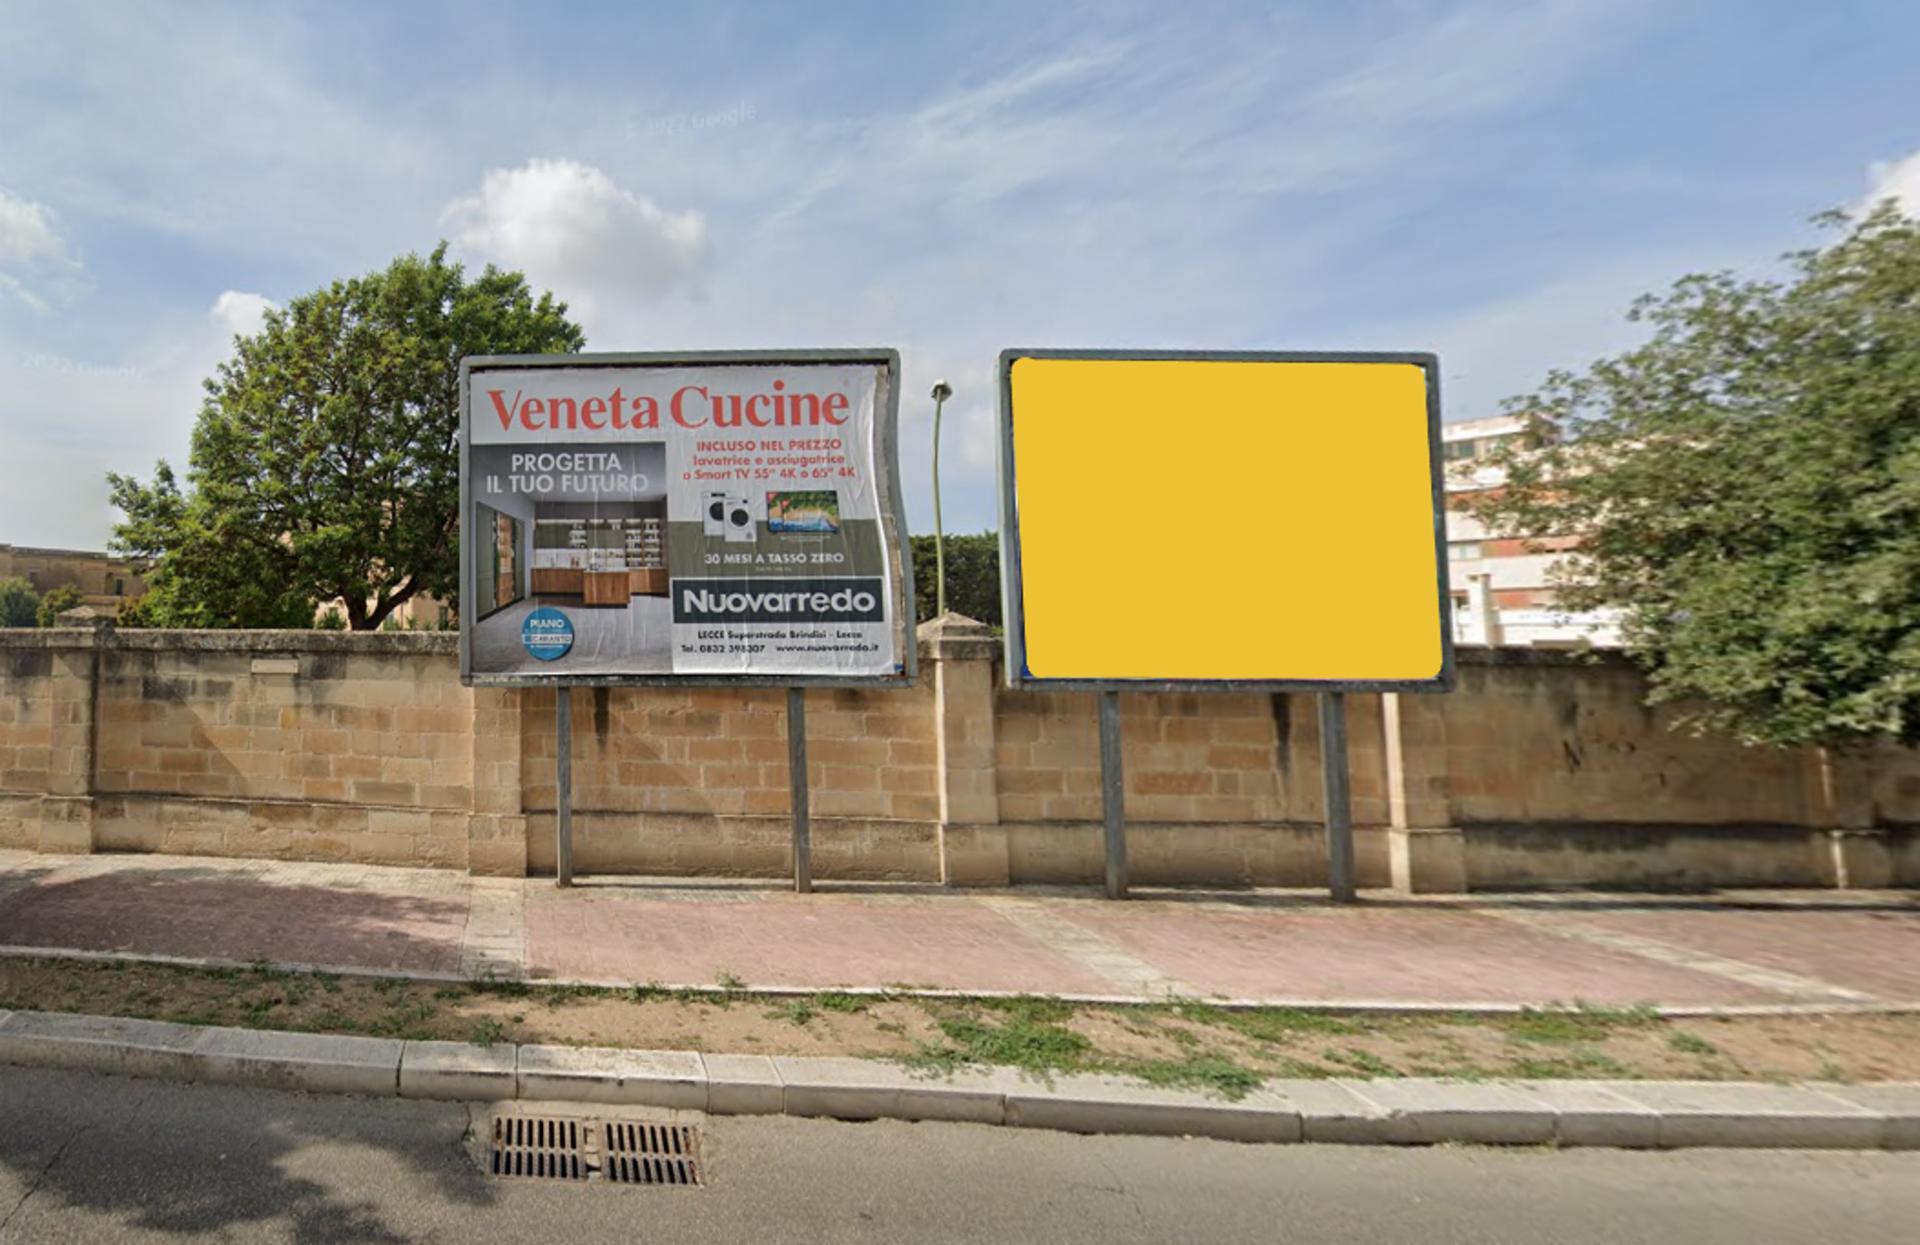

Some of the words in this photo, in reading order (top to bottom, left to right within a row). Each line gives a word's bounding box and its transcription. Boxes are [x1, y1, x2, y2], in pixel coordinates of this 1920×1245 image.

[488, 384, 660, 431] Veneta
[670, 379, 850, 430] Cucine
[696, 440, 756, 451] INCLUSO
[760, 440, 784, 451] NEL
[789, 438, 842, 450] PREZZO
[510, 453, 622, 472] PROGETTA
[693, 455, 751, 466] lavatrice
[754, 457, 763, 465] e
[767, 453, 845, 467] asciugatrice
[694, 469, 731, 480] Smart
[735, 469, 750, 479] TV
[780, 468, 797, 478] 4K
[838, 466, 856, 478] 4K
[486, 475, 502, 493] IL
[508, 475, 554, 493] TUO
[562, 473, 649, 493] FUTURO
[704, 553, 720, 564] 30
[723, 553, 752, 564] MESI
[755, 553, 765, 563] A
[768, 552, 807, 563] TASSO
[810, 552, 845, 563] ZERO
[683, 588, 876, 613] Nuovarredo
[530, 619, 565, 628] PIANO
[697, 630, 725, 639] LECCE
[727, 629, 786, 641] Superstrada
[789, 629, 827, 639] Brindisi
[680, 644, 698, 653] Tel.
[699, 644, 726, 653] 0832
